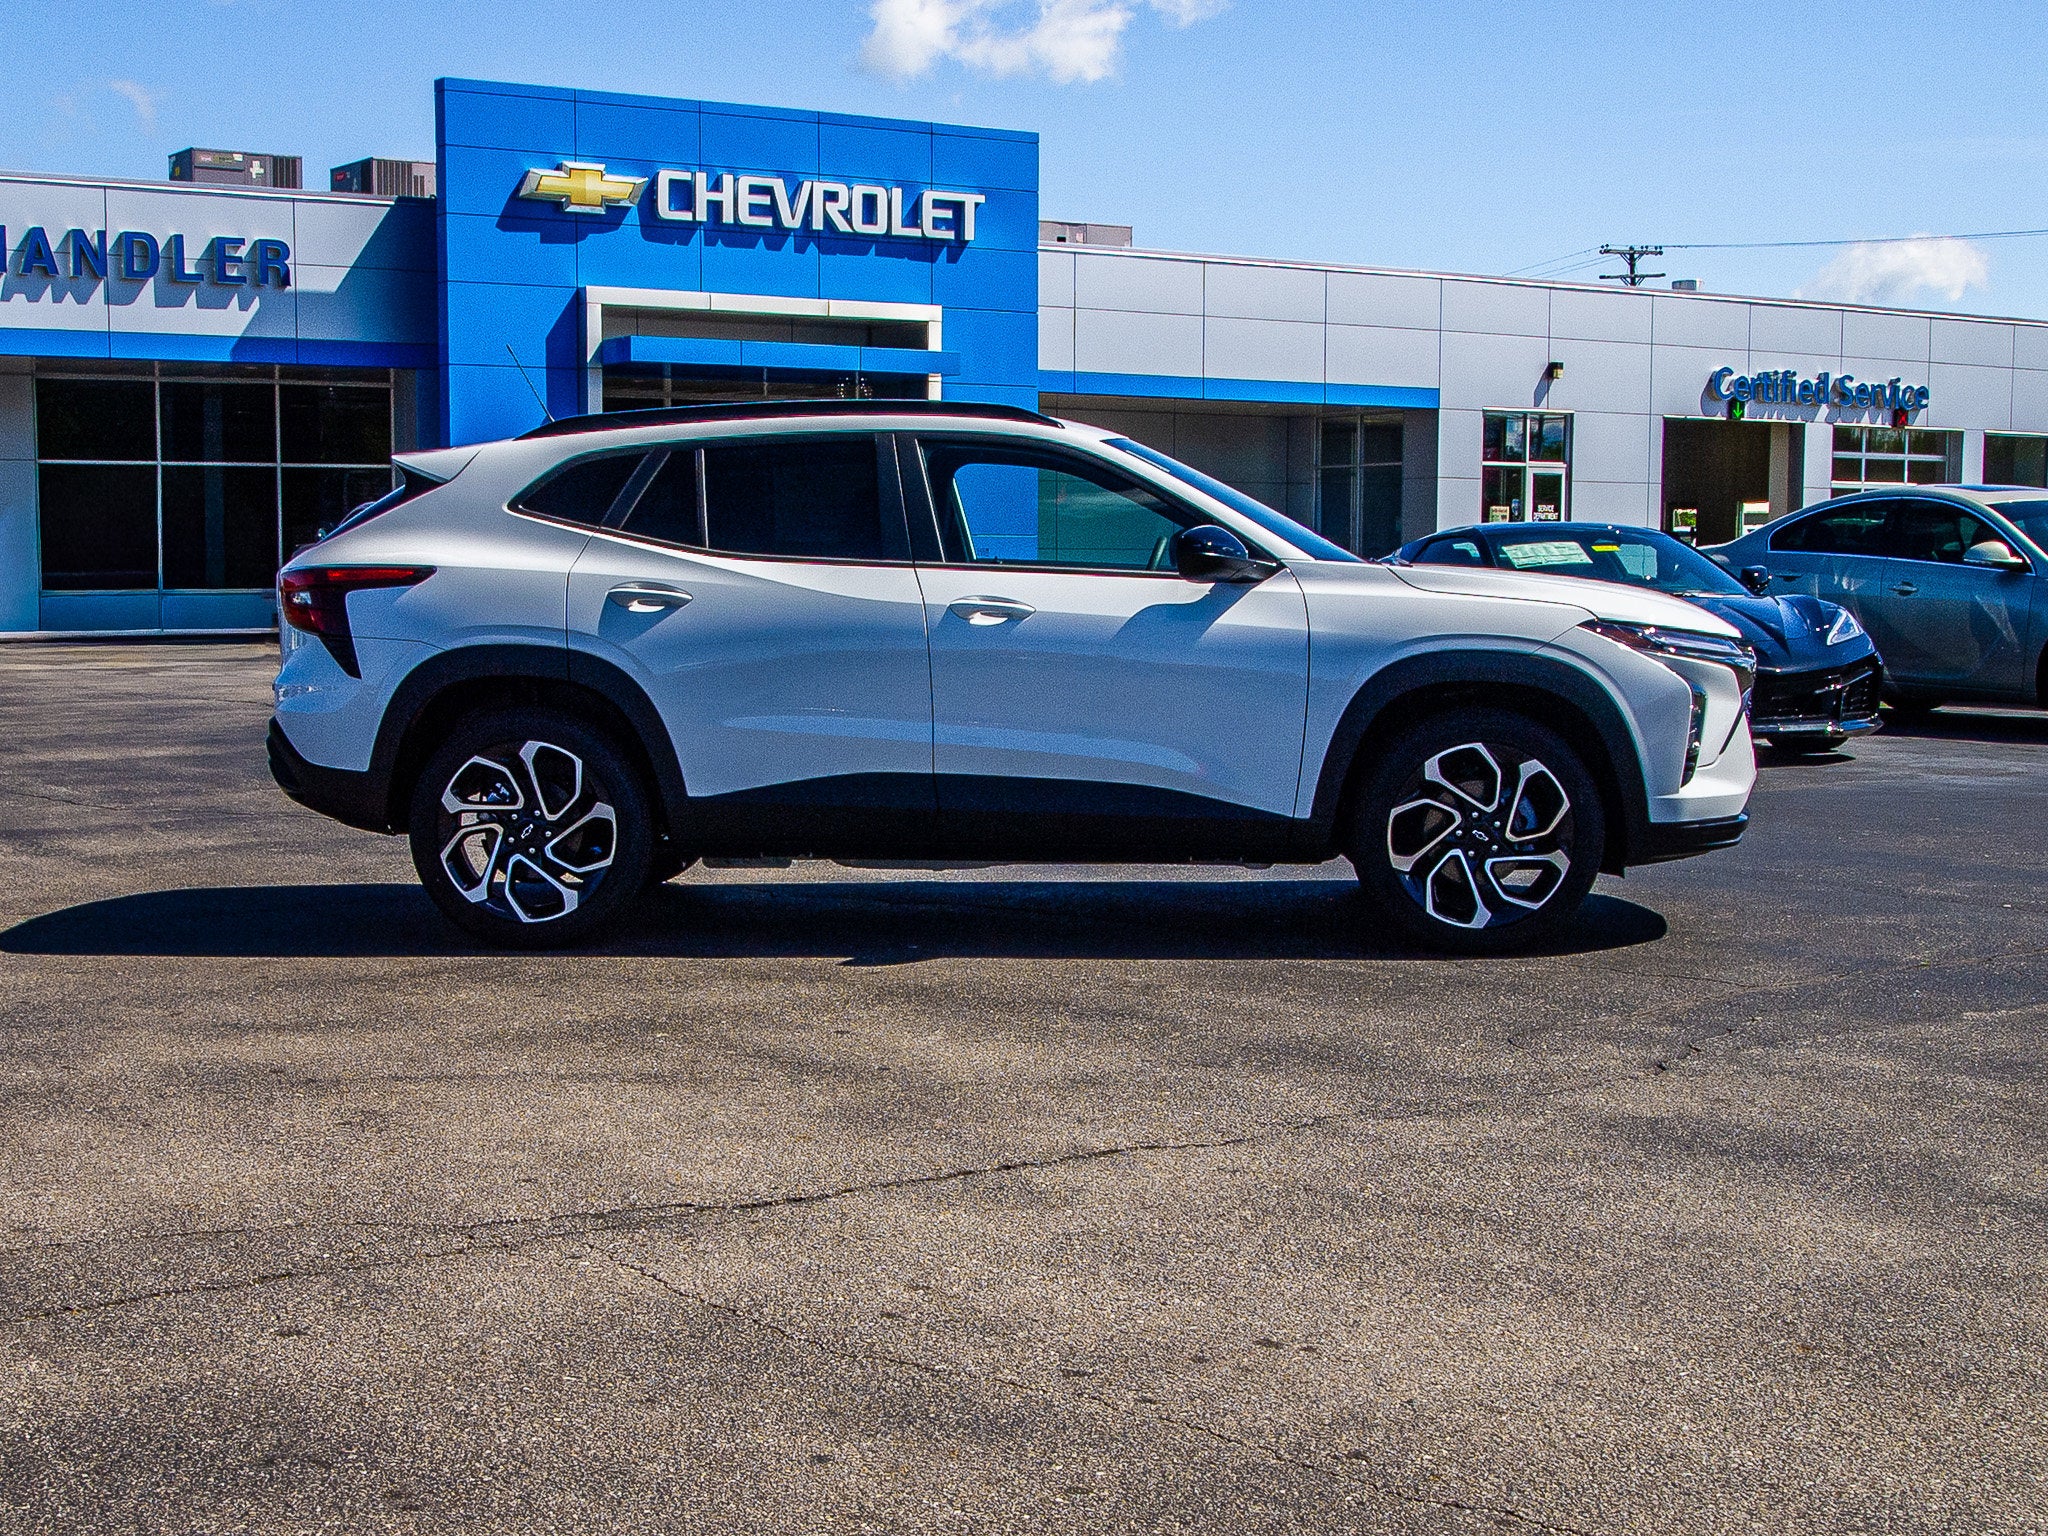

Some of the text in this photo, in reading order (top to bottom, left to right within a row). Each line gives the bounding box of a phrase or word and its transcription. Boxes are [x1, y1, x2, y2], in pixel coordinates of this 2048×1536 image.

[656, 168, 986, 241] CHEVROLET
[0, 224, 292, 287] ANDLER
[1713, 366, 1930, 410] Certified Service
